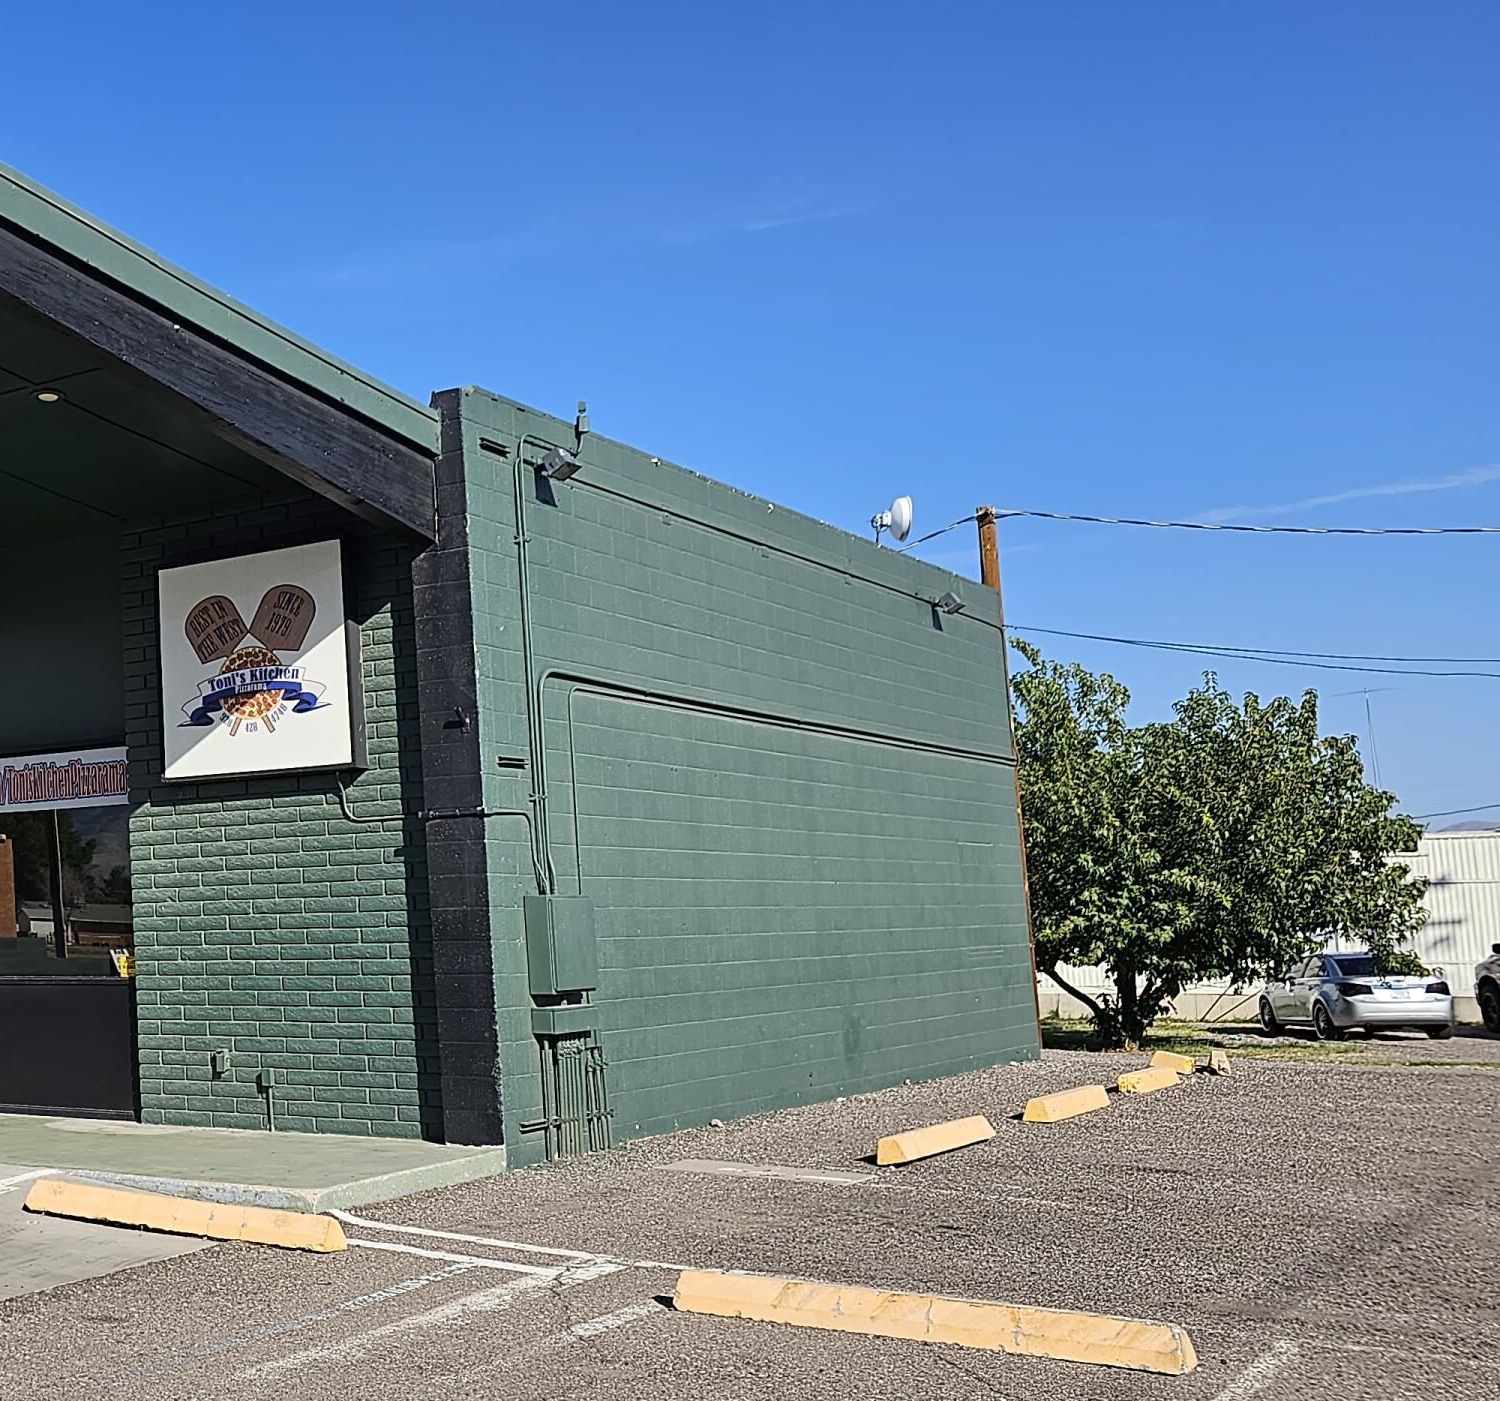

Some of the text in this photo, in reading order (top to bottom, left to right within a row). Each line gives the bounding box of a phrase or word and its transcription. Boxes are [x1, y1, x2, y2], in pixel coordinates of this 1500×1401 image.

[273, 591, 305, 617] SINCE
[189, 600, 229, 638] BEST IN
[265, 612, 293, 637] 1979
[197, 618, 244, 660] THE WEST
[207, 667, 299, 692] Toni's Kitchen
[235, 682, 267, 694] Pizzarama
[245, 721, 258, 732] 428
